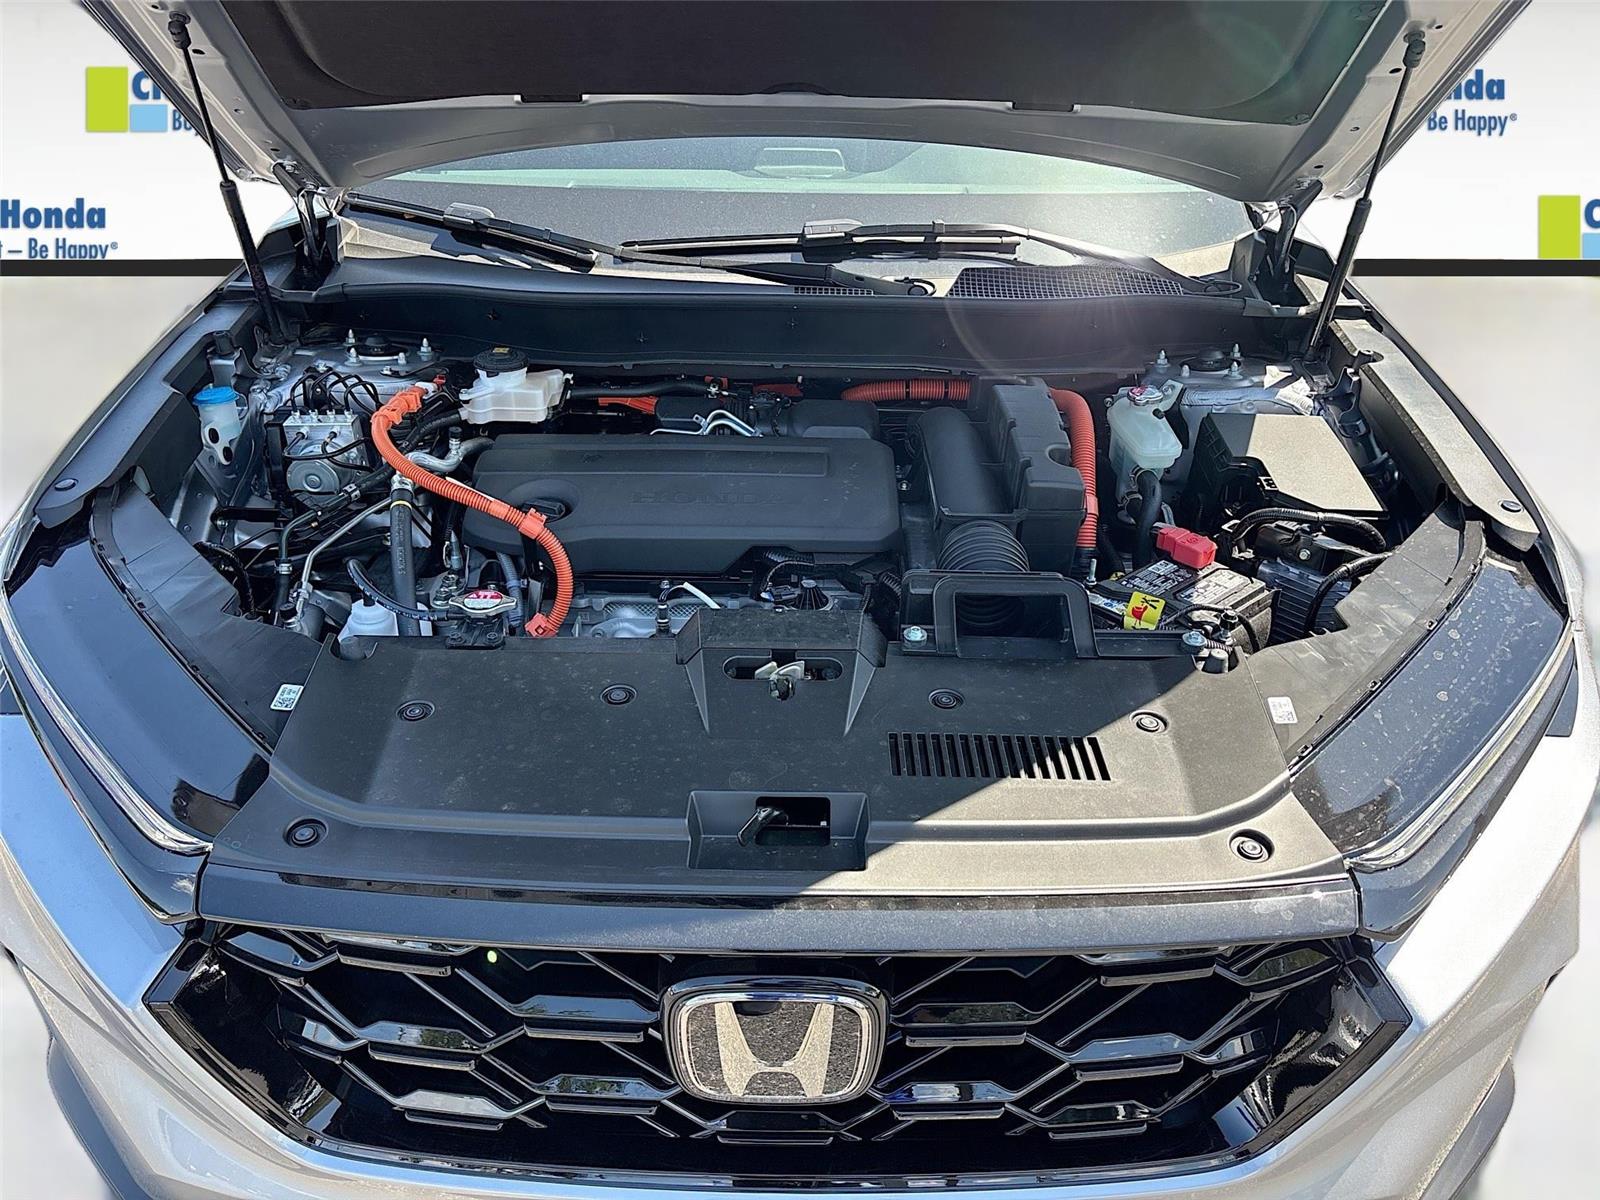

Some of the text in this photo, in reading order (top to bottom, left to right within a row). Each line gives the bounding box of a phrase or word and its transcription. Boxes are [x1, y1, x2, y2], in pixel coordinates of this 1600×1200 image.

[1427, 111, 1448, 131] Be
[0, 198, 106, 229] Honda
[28, 237, 49, 259] Be
